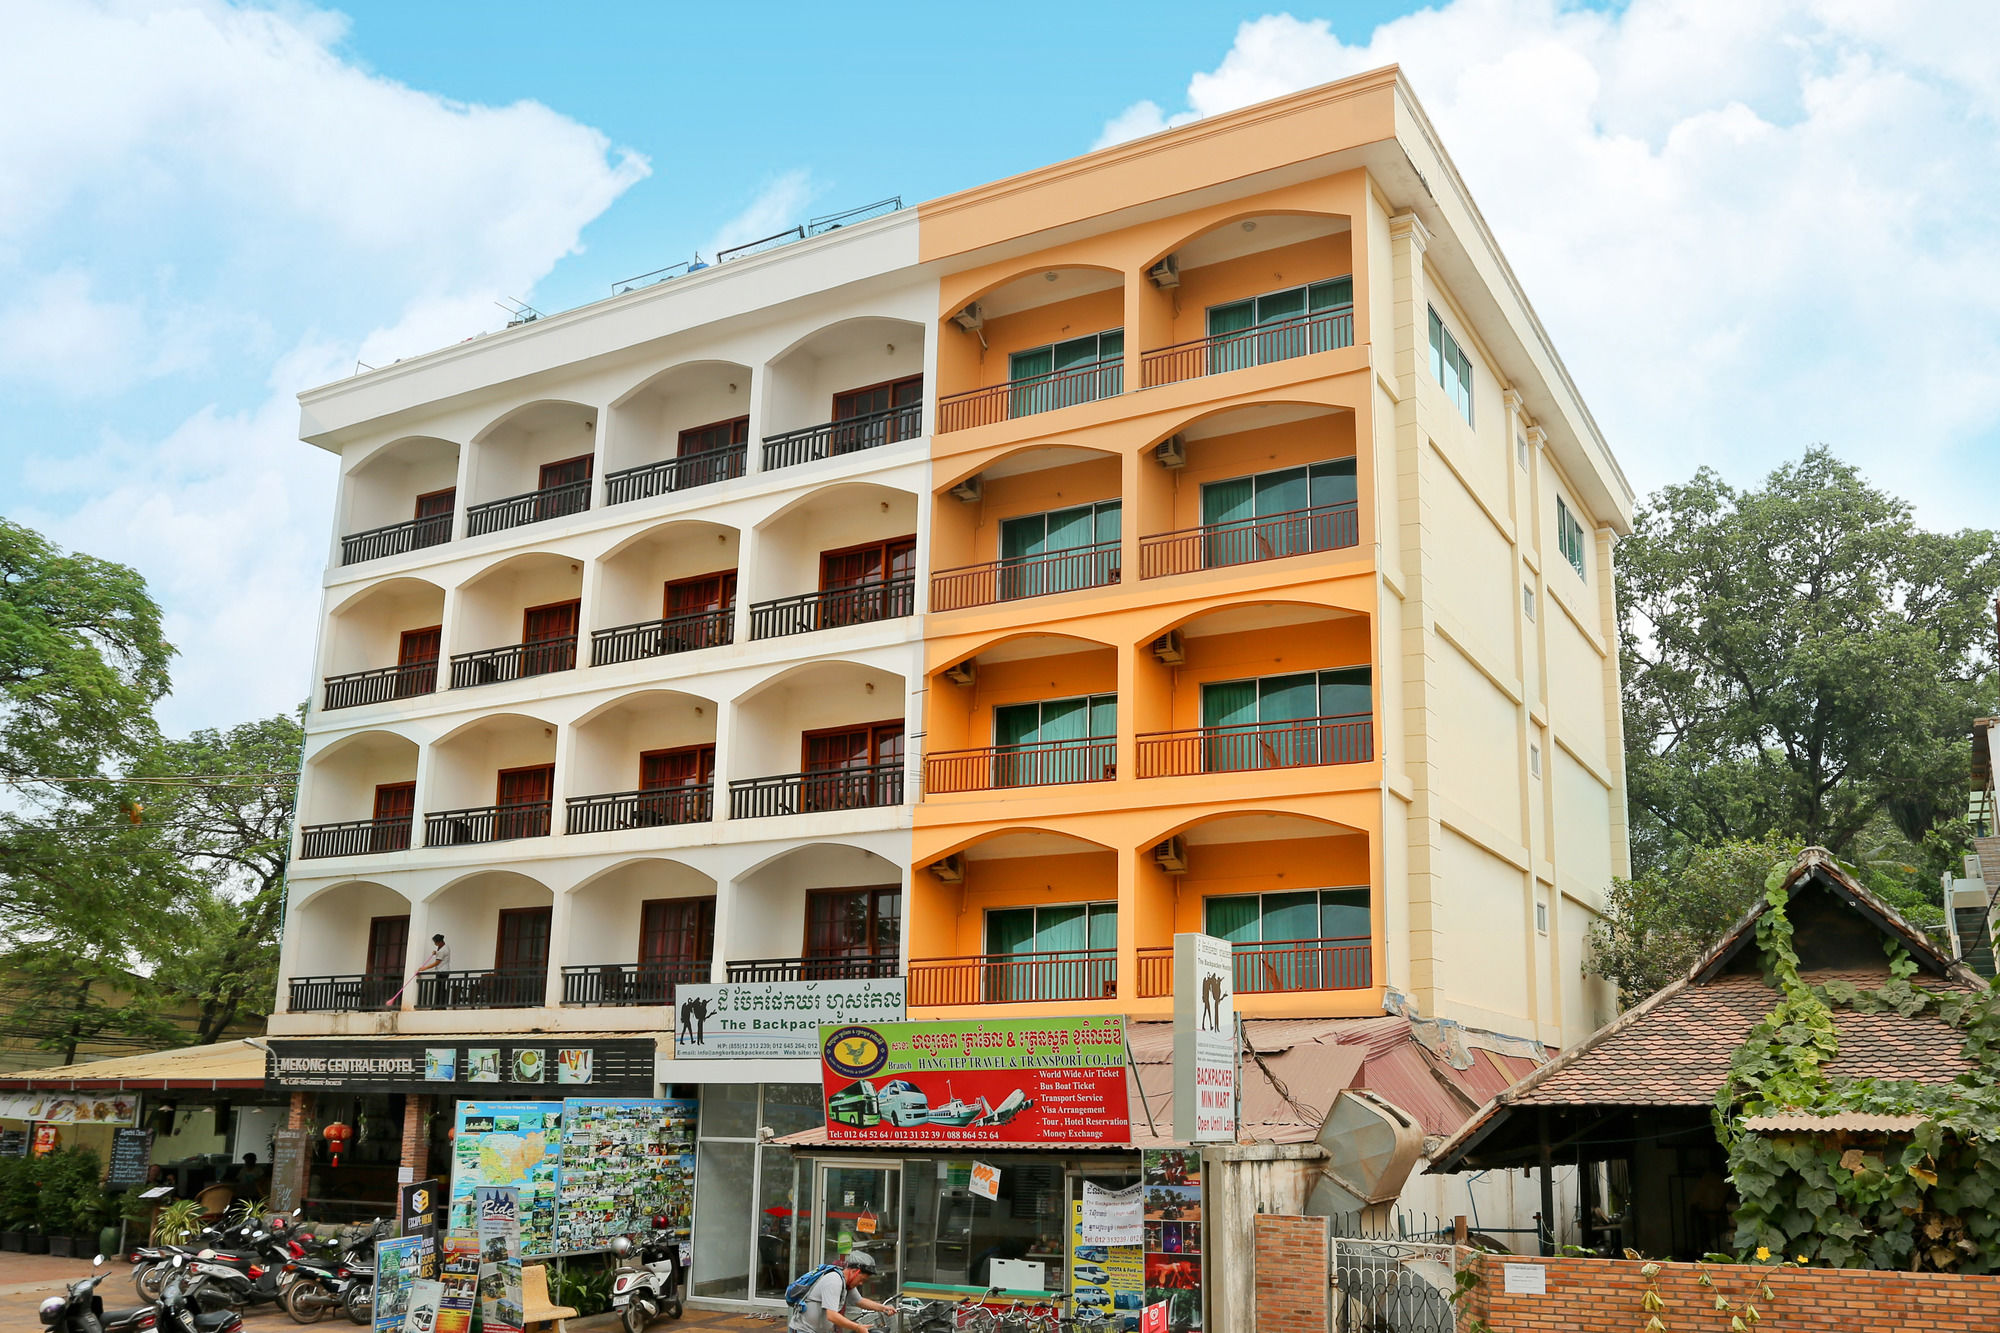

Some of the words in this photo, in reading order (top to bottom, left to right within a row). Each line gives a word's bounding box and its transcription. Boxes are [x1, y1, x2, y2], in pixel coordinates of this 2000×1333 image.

[720, 1019, 746, 1030] The
[1006, 1031, 1016, 1048] &
[280, 1058, 327, 1072] MEKONG
[328, 1058, 378, 1072] CENTRAL
[379, 1058, 416, 1073] HOTEL
[888, 1061, 912, 1070] Branch
[918, 1058, 947, 1069] HANG
[949, 1057, 968, 1069] TEP
[969, 1056, 1007, 1068] TRAVEL
[1009, 1056, 1017, 1067] &
[1020, 1055, 1082, 1067] TRANSPORT
[1039, 1070, 1061, 1078] World
[1063, 1070, 1082, 1078] Wide
[1083, 1070, 1095, 1078] Air
[1096, 1069, 1119, 1077] Ticket
[1197, 1067, 1232, 1087] BACKPACKER
[1040, 1082, 1053, 1090] Bus
[1055, 1082, 1071, 1090] Boat
[1072, 1082, 1095, 1090] Ticket
[1041, 1094, 1076, 1103] Transport
[1076, 1094, 1103, 1102] Service
[1201, 1090, 1214, 1108] MINI
[1215, 1091, 1230, 1109] MART
[1057, 1106, 1105, 1115] Arrangement
[1085, 1117, 1128, 1125] Reservation
[1198, 1115, 1209, 1135] Open
[1223, 1116, 1234, 1131] Late
[829, 1131, 842, 1139] Tel:
[844, 1131, 857, 1139] 012
[859, 1131, 868, 1139] 64
[869, 1131, 878, 1139] 52
[879, 1131, 889, 1139] 64
[894, 1131, 907, 1139] 012
[910, 1131, 918, 1139] 31
[920, 1131, 930, 1139] 32
[931, 1131, 940, 1139] 39
[947, 1131, 961, 1139] 088
[962, 1131, 976, 1139] 864
[978, 1131, 987, 1139] 52
[989, 1131, 999, 1139] 64
[1043, 1130, 1067, 1139] Money
[1068, 1130, 1103, 1139] Exchange
[482, 1199, 514, 1217] Ride
